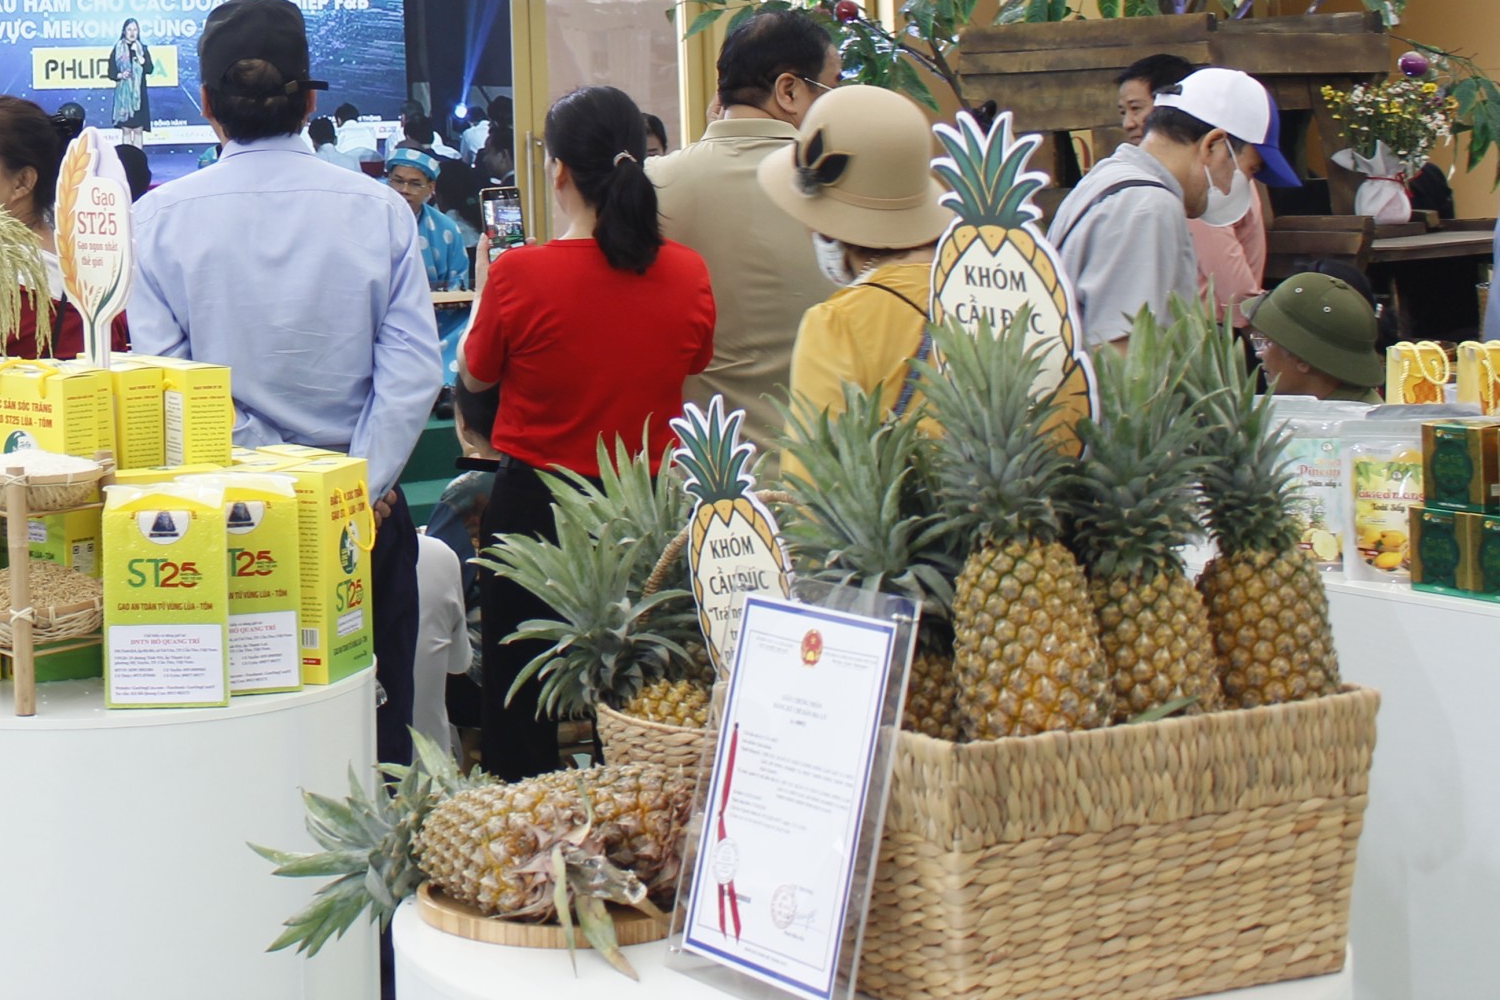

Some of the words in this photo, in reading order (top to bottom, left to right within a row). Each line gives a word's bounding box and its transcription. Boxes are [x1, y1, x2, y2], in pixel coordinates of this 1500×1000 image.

[140, 16, 198, 37] CÙNG
[91, 187, 115, 212] Gạo
[77, 210, 117, 236] ST25
[963, 262, 1028, 293] KHÓM
[1000, 308, 1045, 335] ĐC
[5, 414, 20, 426] ST25
[21, 415, 33, 426] LÚA
[39, 416, 53, 428] TÔM
[709, 532, 756, 560] KHÓM
[128, 558, 200, 588] ST25
[227, 548, 276, 577] T25
[275, 587, 288, 598] TÔM
[336, 578, 364, 613] ST25
[131, 602, 140, 611] AN
[200, 601, 213, 611] TÔM
[240, 625, 264, 635] QUANG
